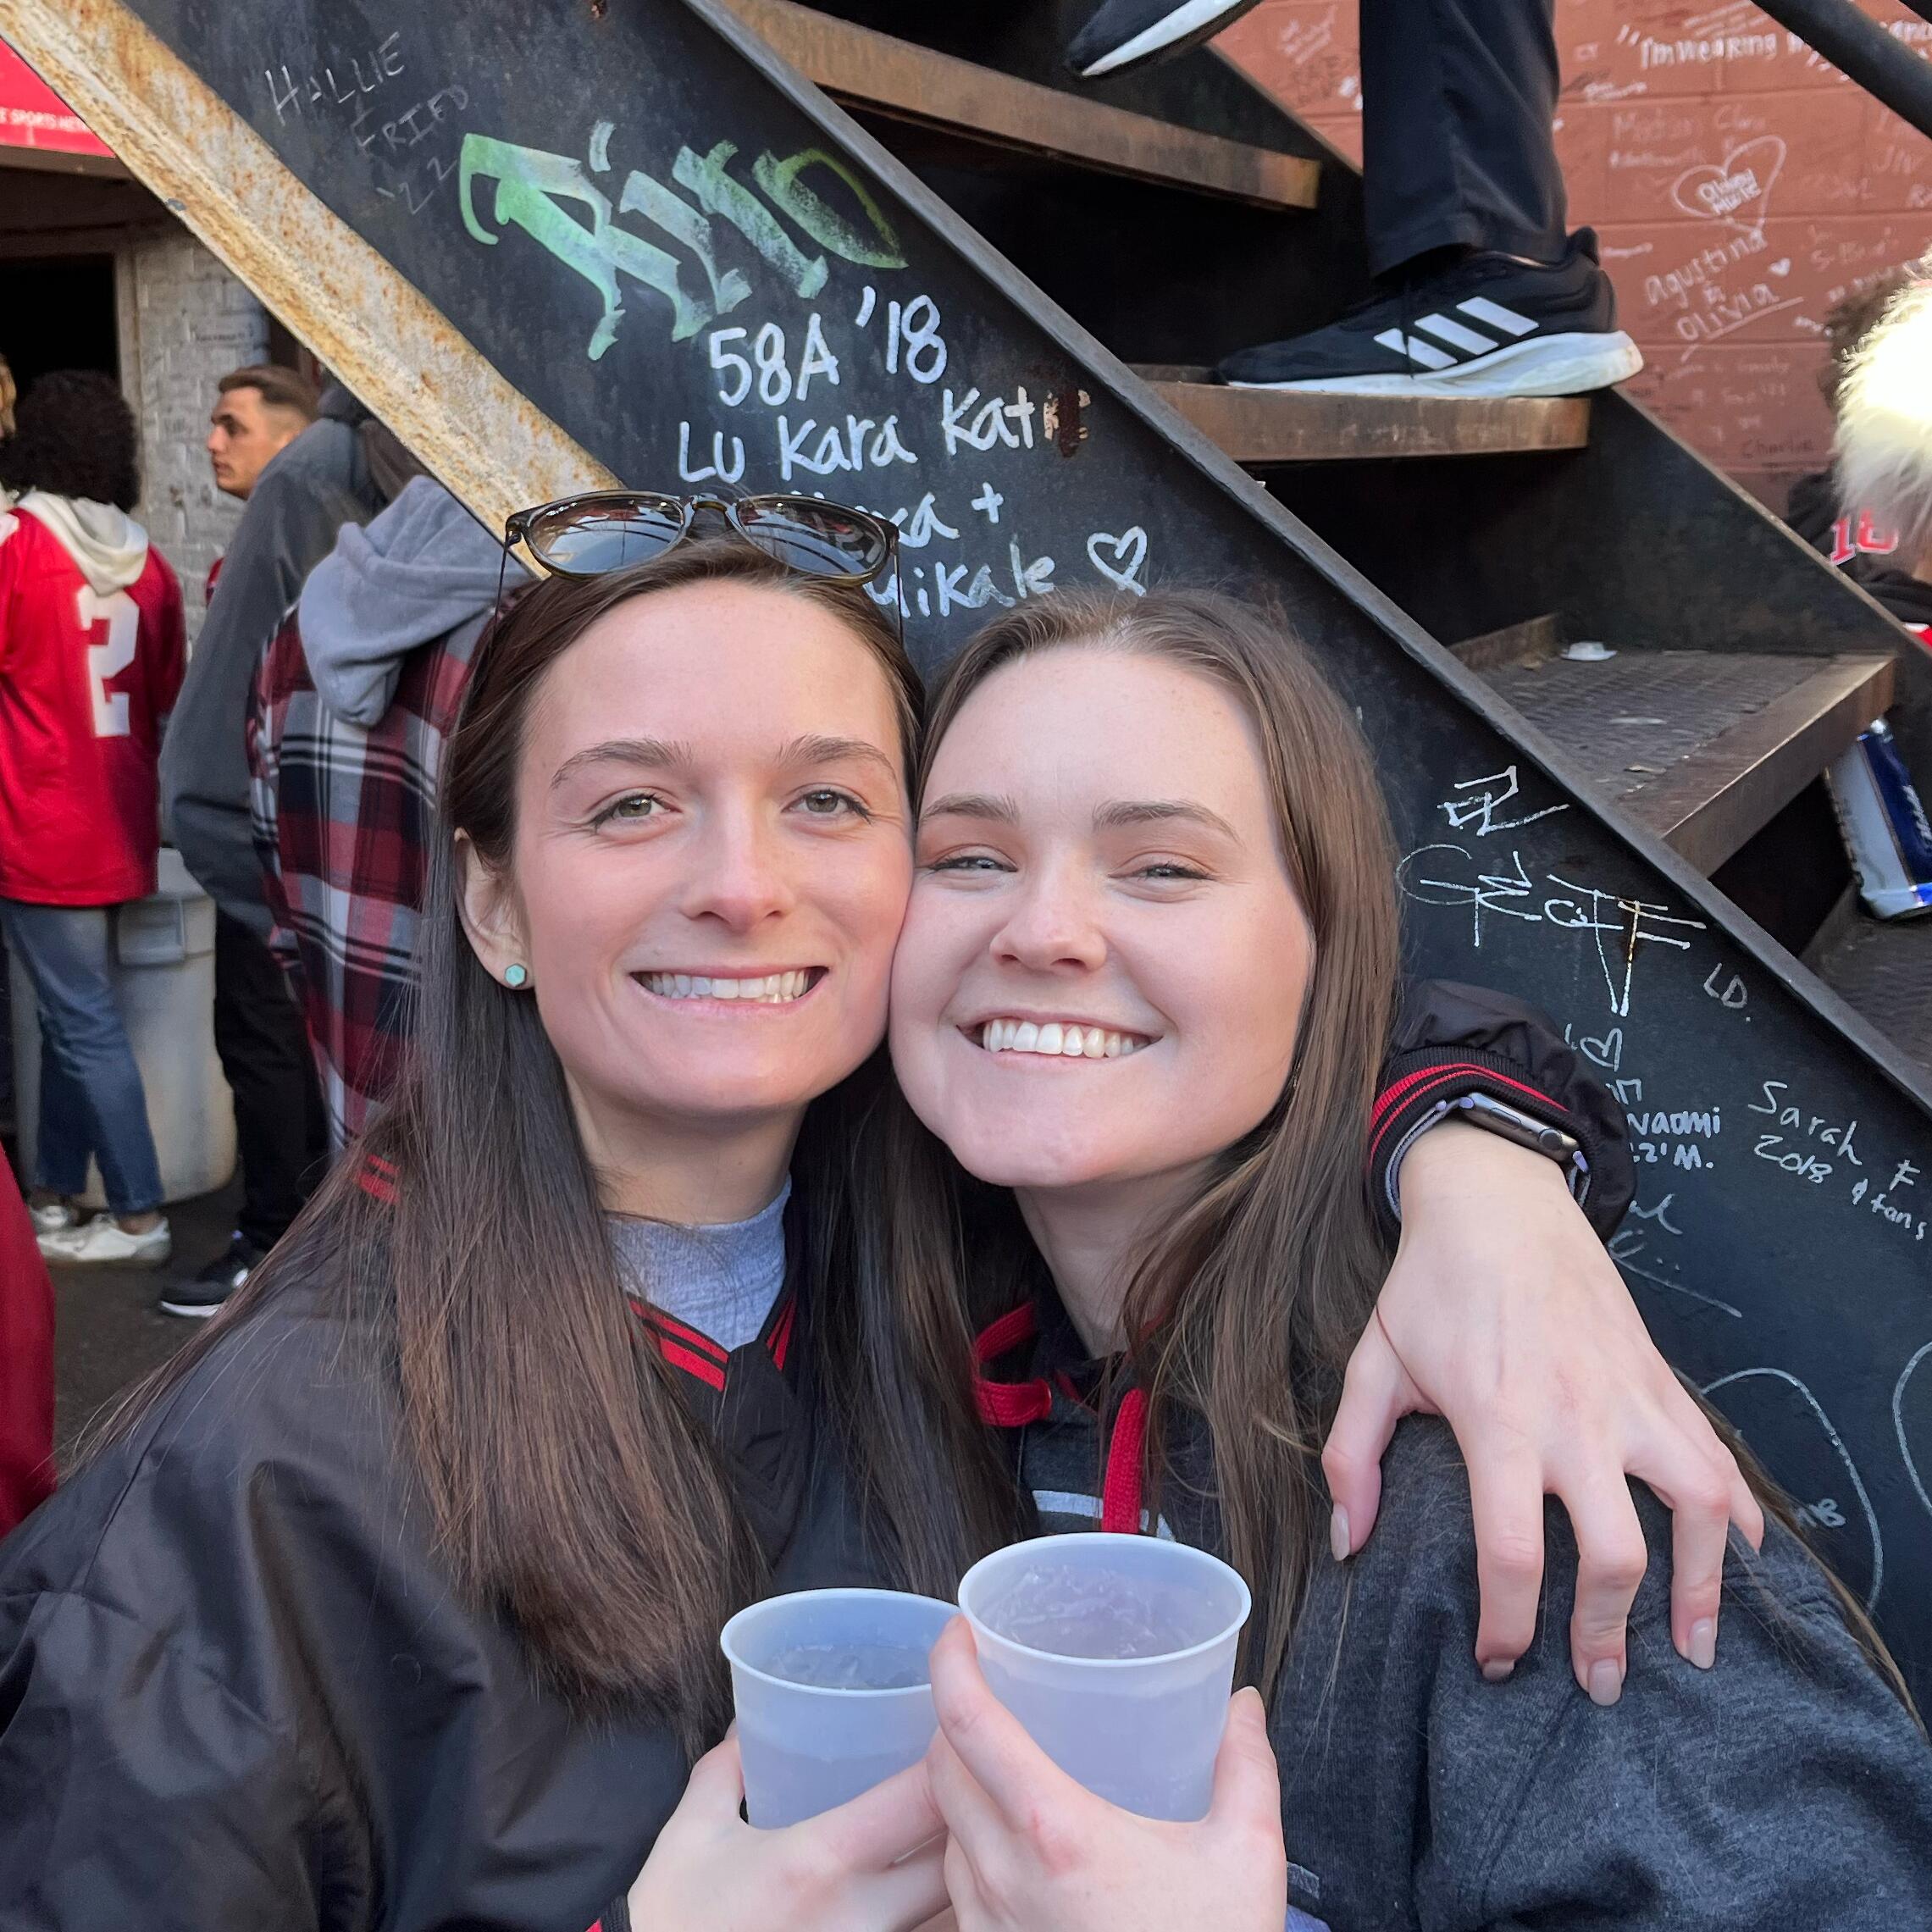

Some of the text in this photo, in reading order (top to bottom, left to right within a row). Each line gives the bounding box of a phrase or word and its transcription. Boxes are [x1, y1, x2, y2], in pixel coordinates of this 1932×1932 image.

[710, 285, 948, 407] 58A '18
[778, 414, 919, 482] Kara
[76, 582, 141, 739] 2
[1747, 1080, 1863, 1165] Sarah
[1753, 1134, 1833, 1183] 2018
